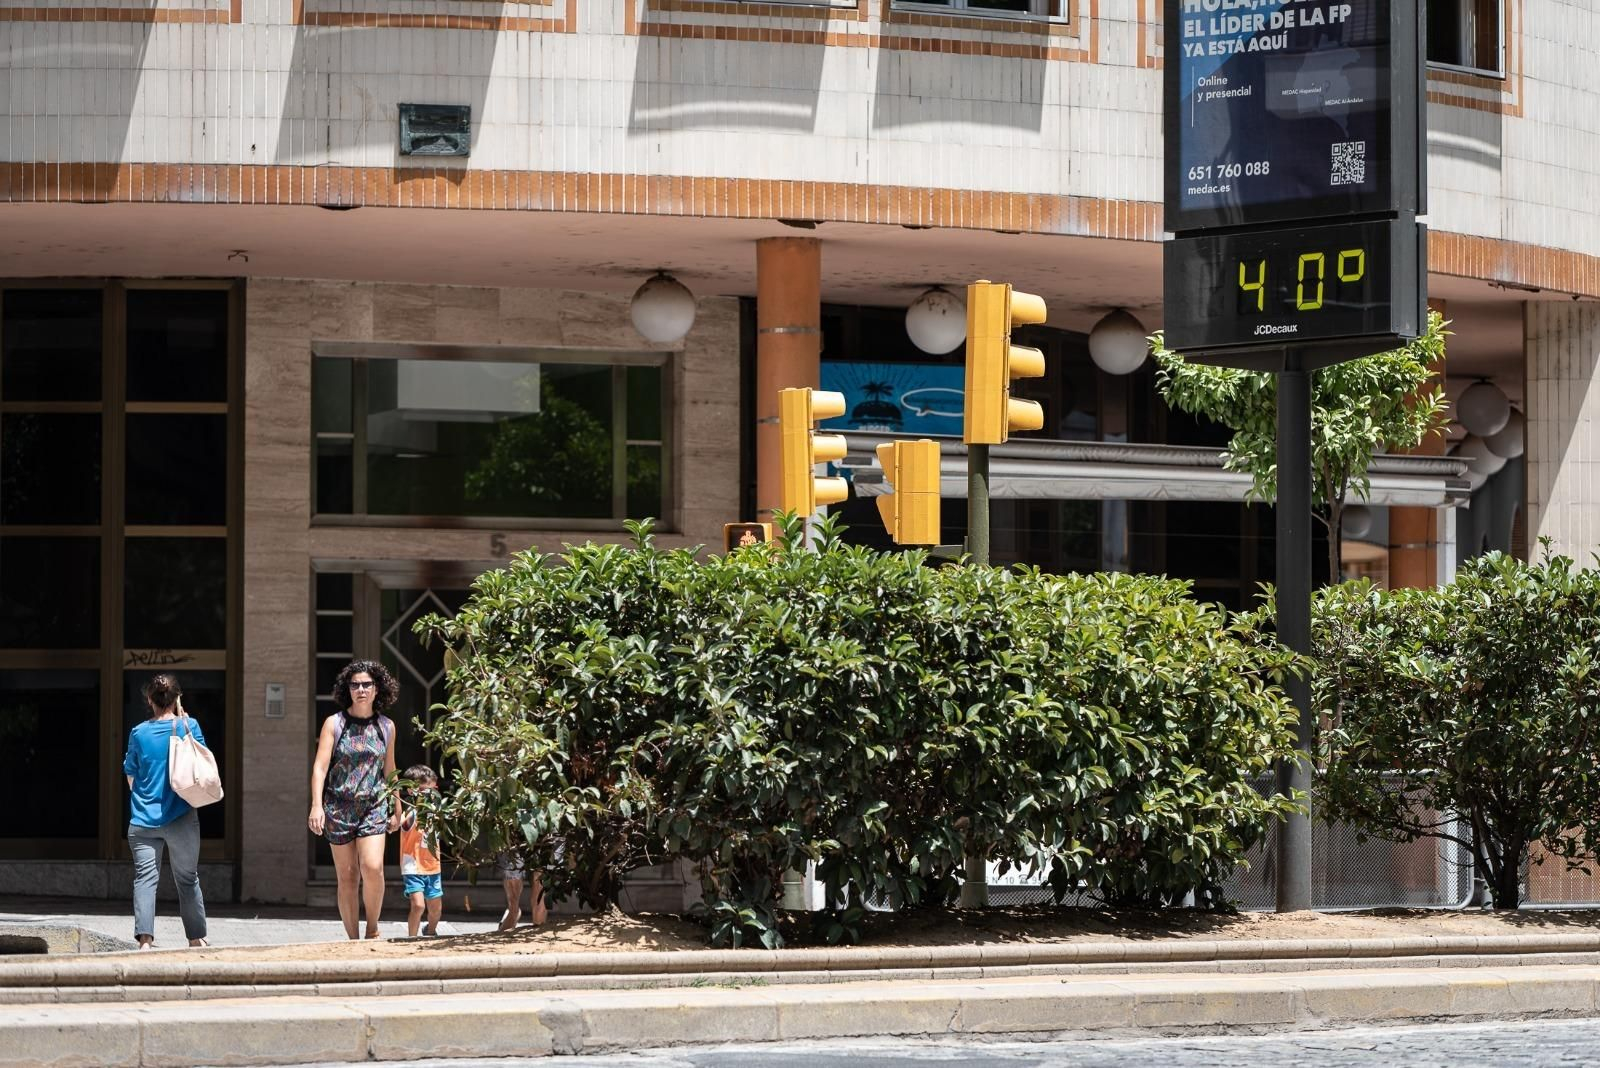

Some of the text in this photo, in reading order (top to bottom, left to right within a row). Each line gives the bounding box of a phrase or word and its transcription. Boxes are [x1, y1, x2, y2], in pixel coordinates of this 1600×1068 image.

[1184, 4, 1352, 38] EL LÍDER DE LA FP
[1183, 31, 1288, 57] YA ESTÁ AQUÍ
[1197, 75, 1228, 87] Online
[1197, 85, 1252, 103] y presencial
[1188, 161, 1270, 181] 651 760 088
[1188, 183, 1231, 195] medac.es
[491, 533, 507, 558] 5
